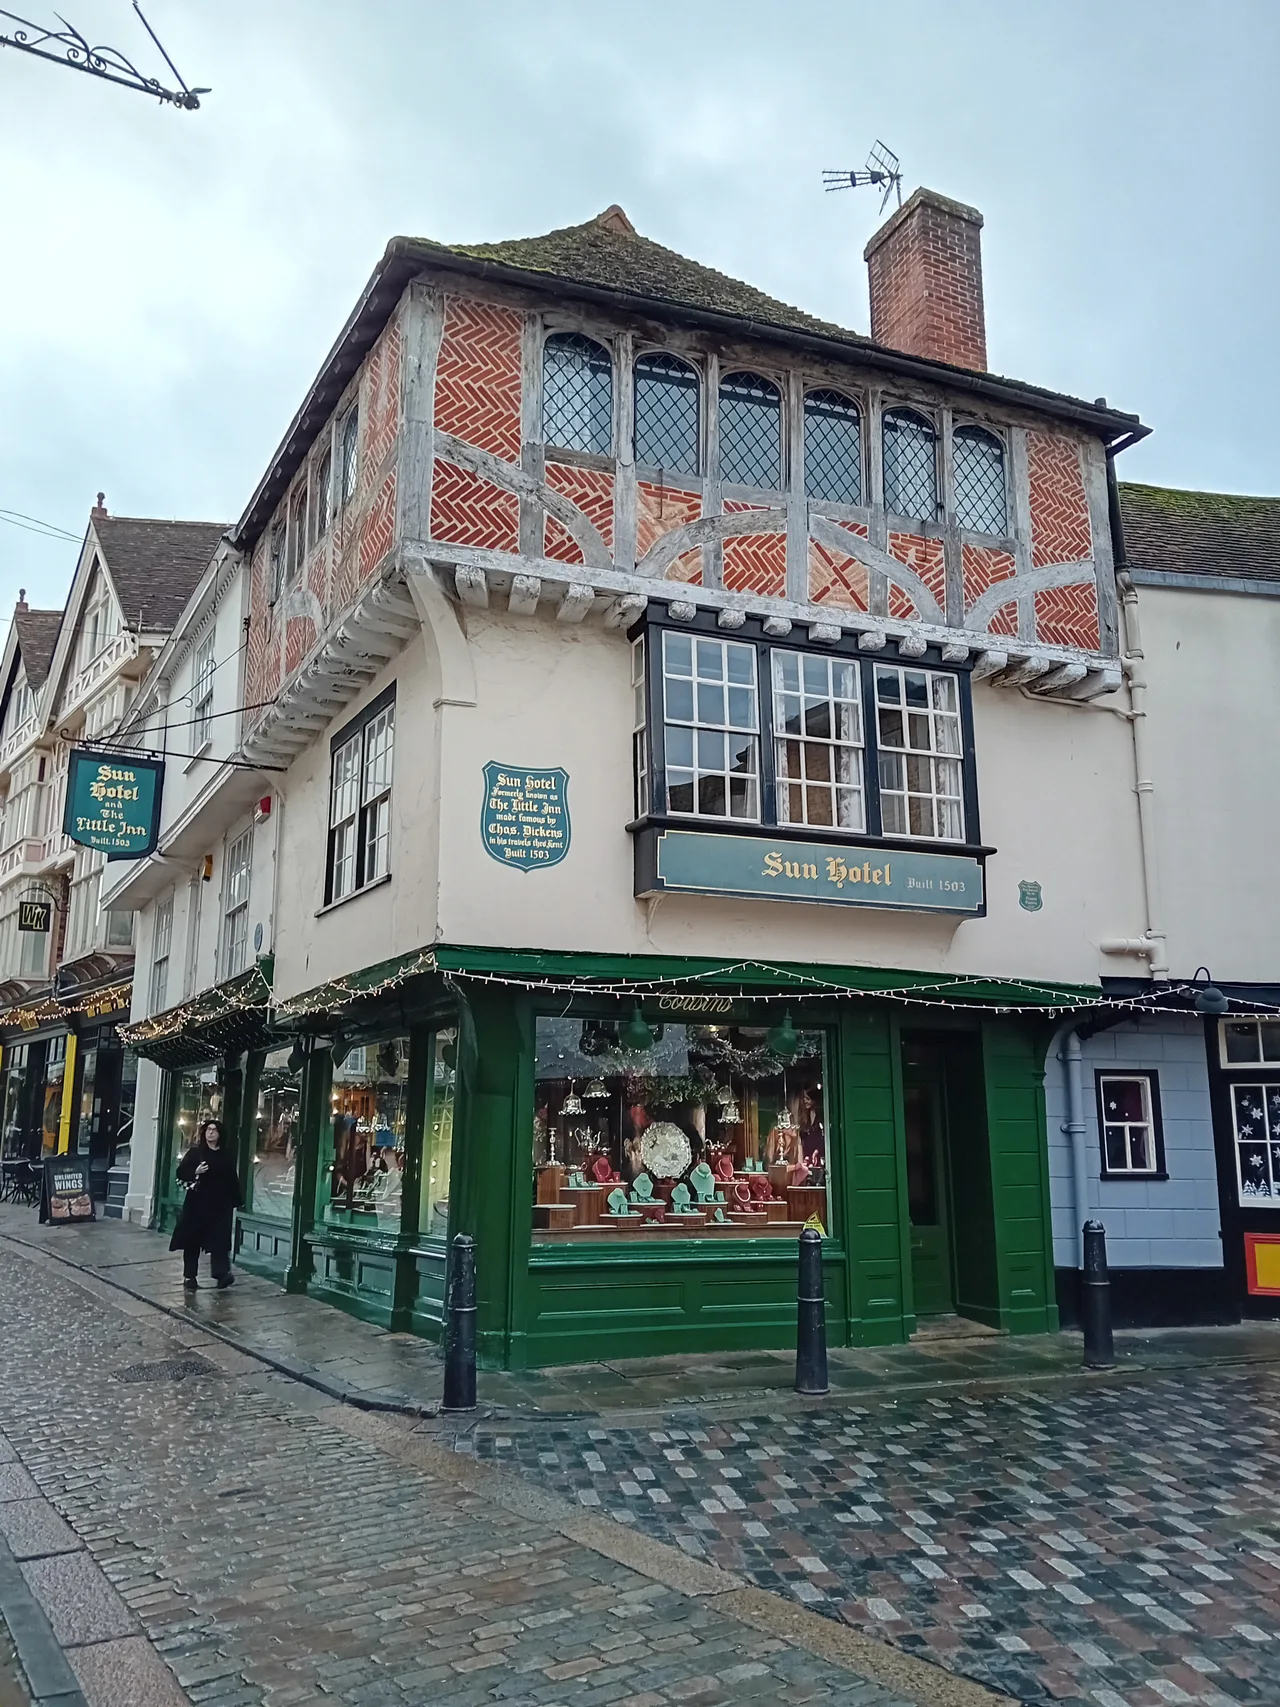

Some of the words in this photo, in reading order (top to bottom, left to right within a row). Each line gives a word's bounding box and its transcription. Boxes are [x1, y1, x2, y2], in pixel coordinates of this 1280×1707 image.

[96, 765, 136, 782] Sun
[496, 773, 521, 788] Sun
[525, 775, 556, 791] Hotel
[90, 782, 139, 801] Hotel
[491, 787, 524, 800] Formerly
[525, 790, 548, 800] known
[105, 801, 123, 809] and
[489, 798, 509, 812] The
[511, 799, 538, 813] Little
[541, 802, 561, 814] Inn
[100, 809, 124, 819] The
[496, 813, 517, 822] made
[519, 813, 546, 824] famous
[547, 816, 556, 828] by
[76, 817, 116, 832] Little
[117, 821, 147, 837] Inn
[488, 823, 520, 836] Chas.
[523, 825, 563, 839] Dickens
[112, 839, 130, 847] 1503
[497, 836, 507, 845] his
[508, 838, 531, 847] travels
[546, 840, 563, 849] Kent
[503, 847, 526, 858] Built
[530, 850, 550, 859] 1503
[761, 852, 819, 880] Sun
[825, 857, 892, 888] Hotel
[907, 877, 933, 890] Built
[939, 880, 966, 892] 1503
[658, 988, 733, 1013] Cousins
[54, 1172, 83, 1181] UNLIMITED
[55, 1180, 83, 1190] WINGS
